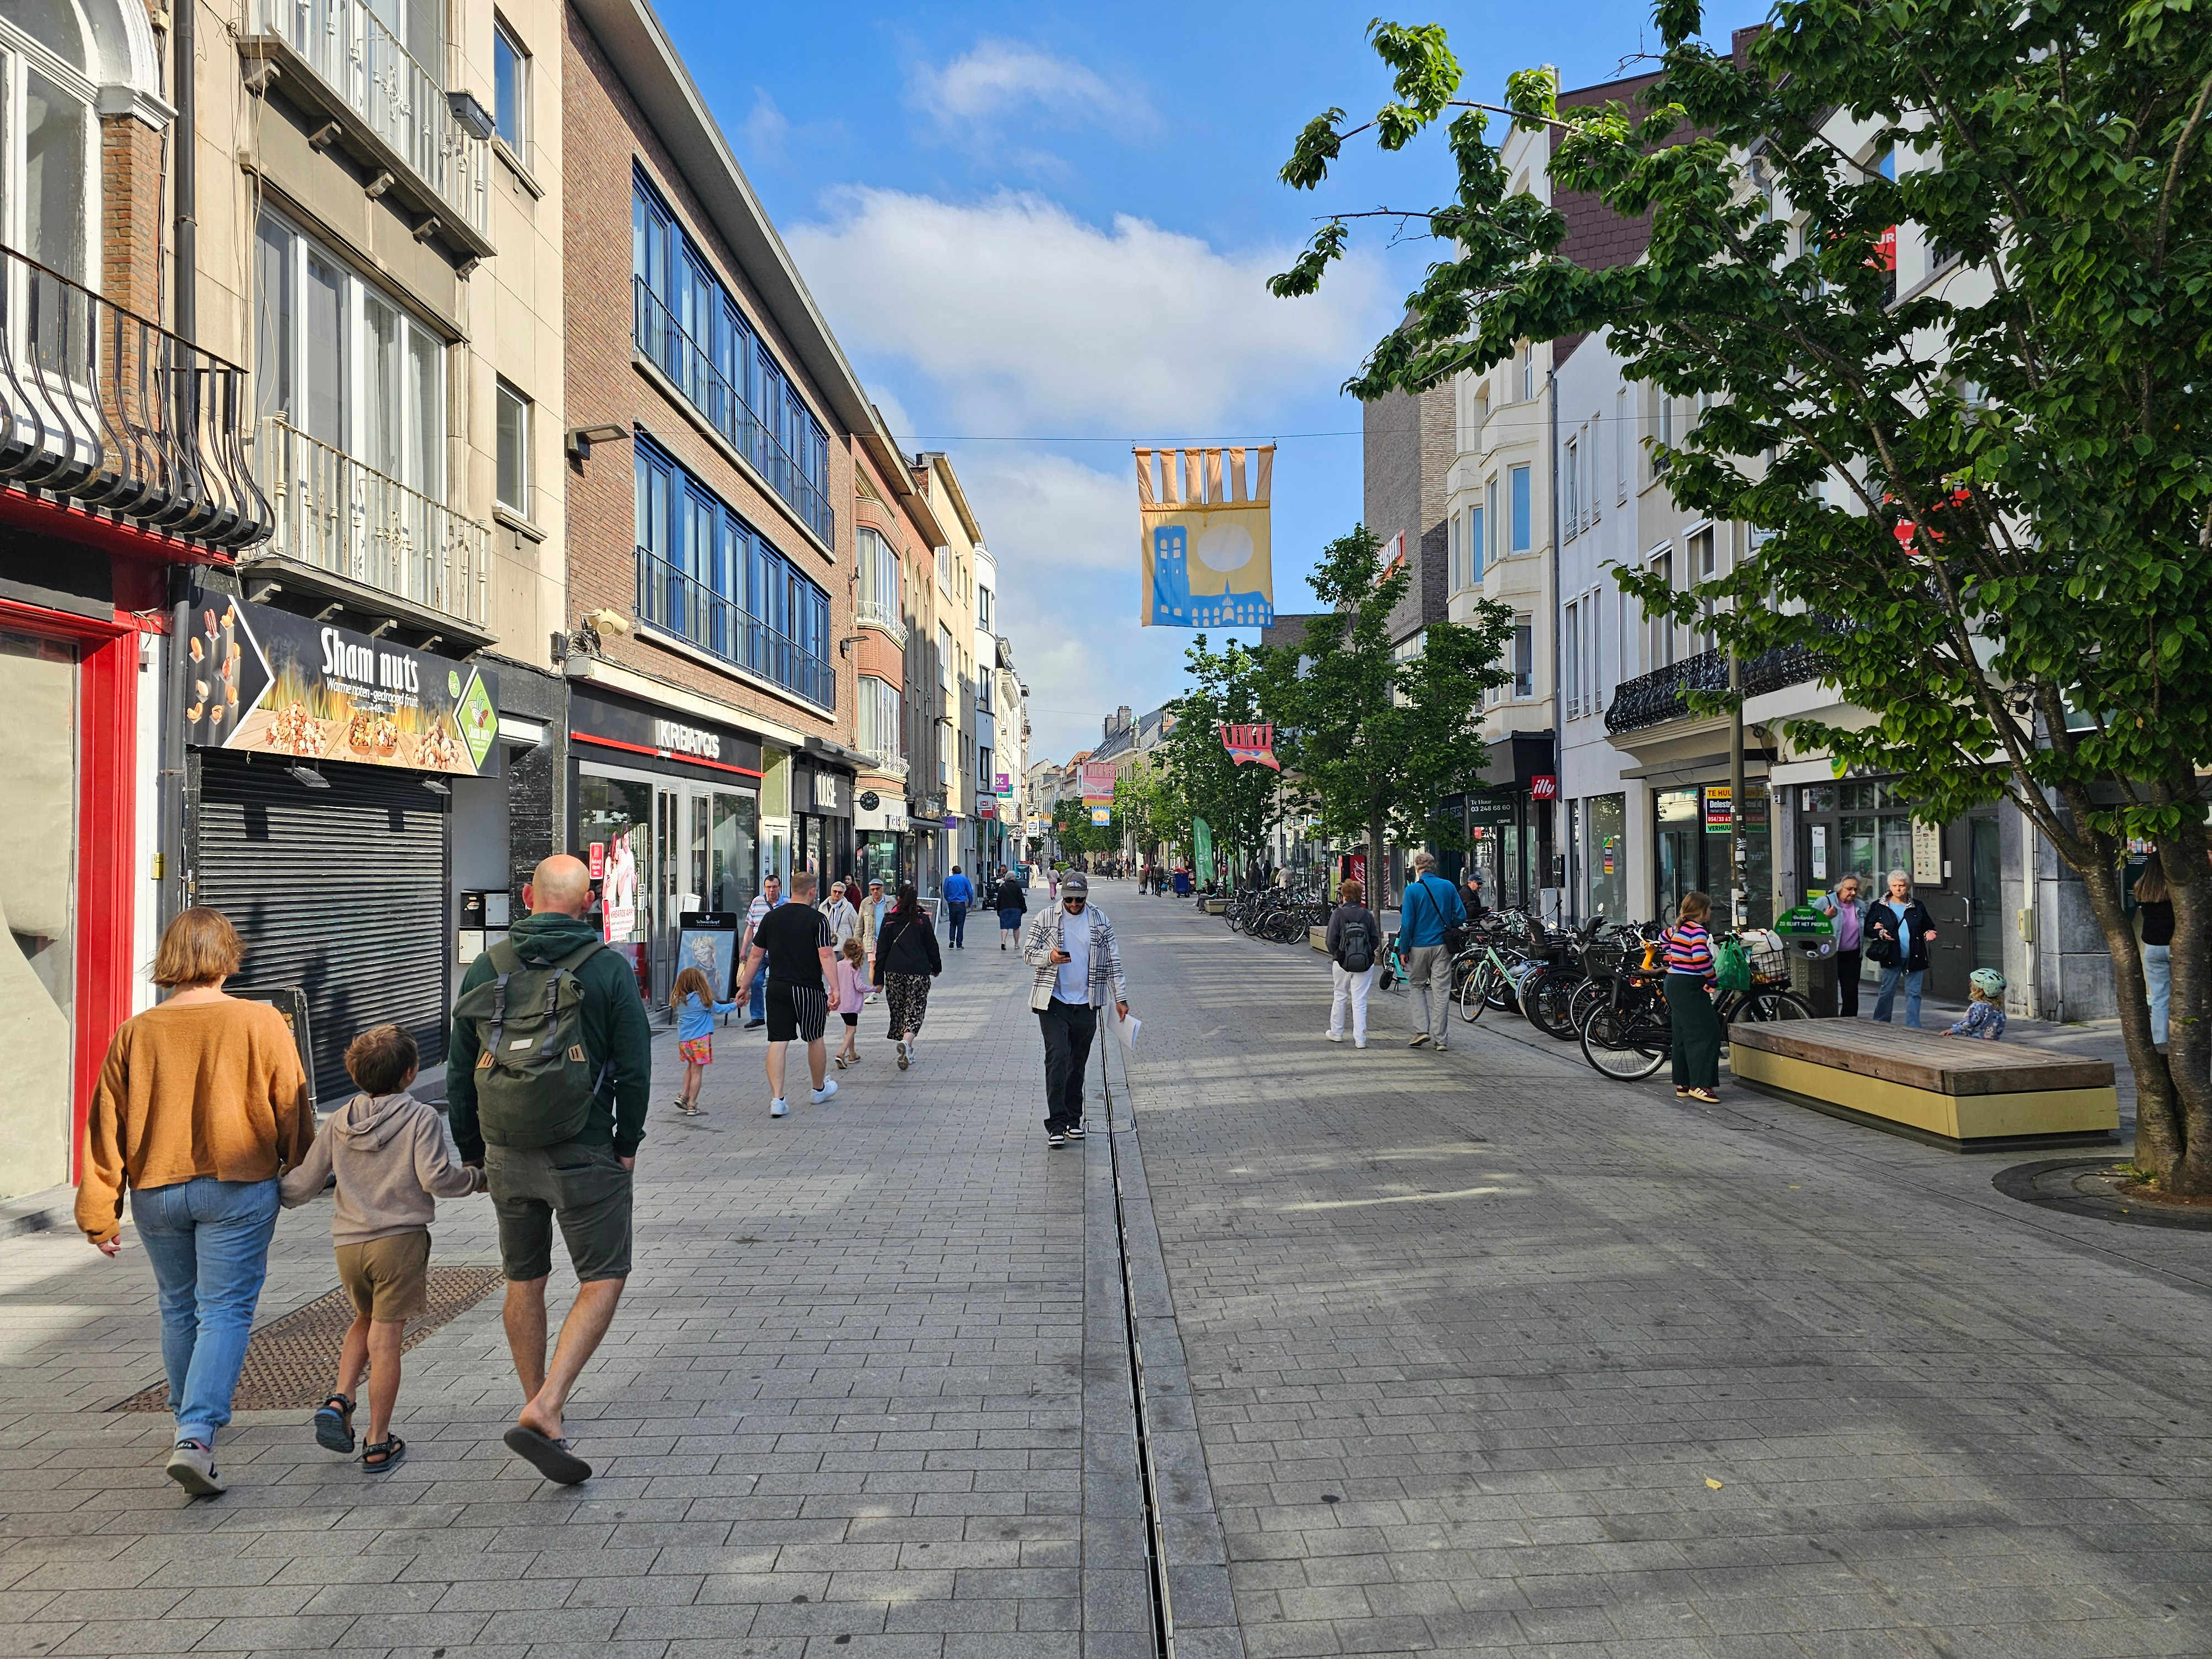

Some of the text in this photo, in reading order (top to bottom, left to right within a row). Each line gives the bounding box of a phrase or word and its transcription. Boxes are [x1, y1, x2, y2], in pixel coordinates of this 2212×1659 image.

[321, 627, 419, 693] Sham nuts
[327, 677, 351, 695] Warme
[352, 684, 370, 698] noten
[373, 690, 403, 707] gedroogd
[405, 693, 419, 708] fruit
[655, 719, 719, 759] KREATOS
[1533, 779, 1555, 797] illy
